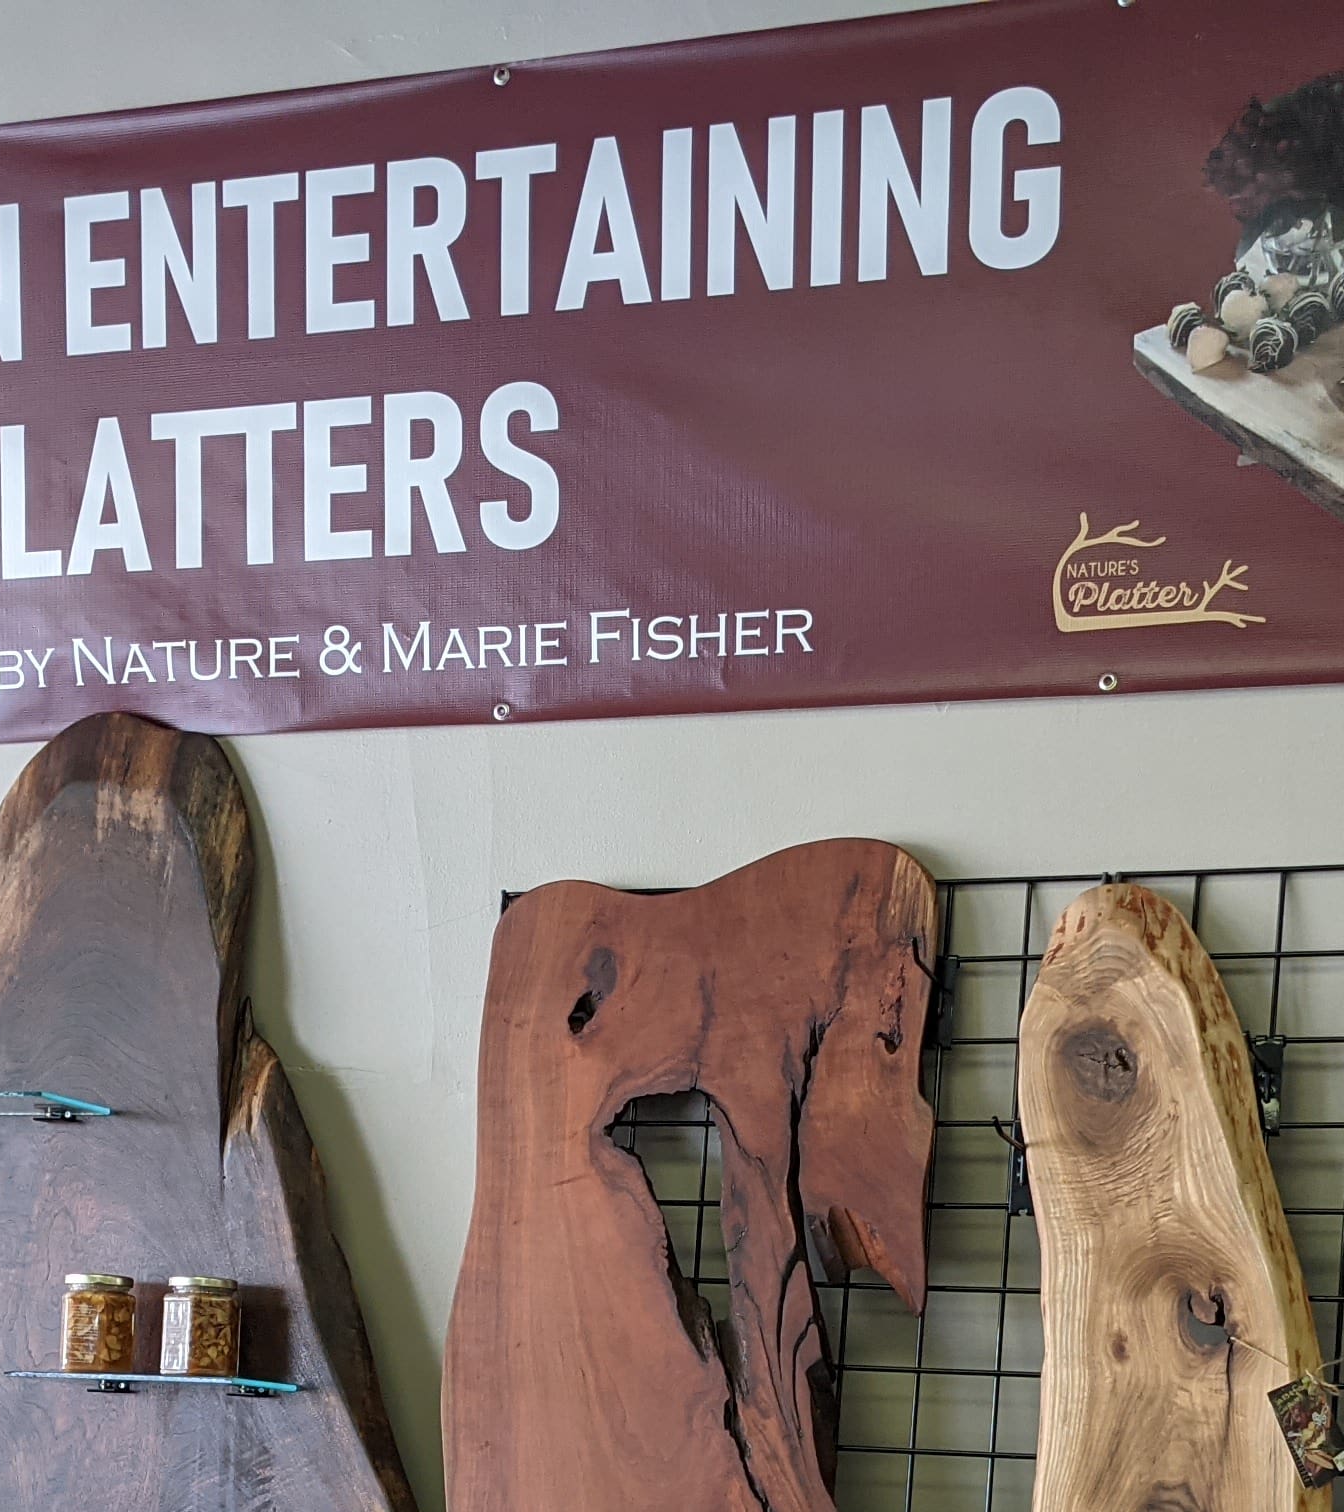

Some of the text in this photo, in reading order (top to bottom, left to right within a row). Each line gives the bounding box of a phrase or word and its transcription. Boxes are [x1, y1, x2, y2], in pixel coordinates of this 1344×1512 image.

[64, 87, 1060, 356] ENTERTAINING
[1067, 559, 1139, 579] NATURE'S
[1068, 580, 1199, 613] Platter
[319, 624, 363, 676] &
